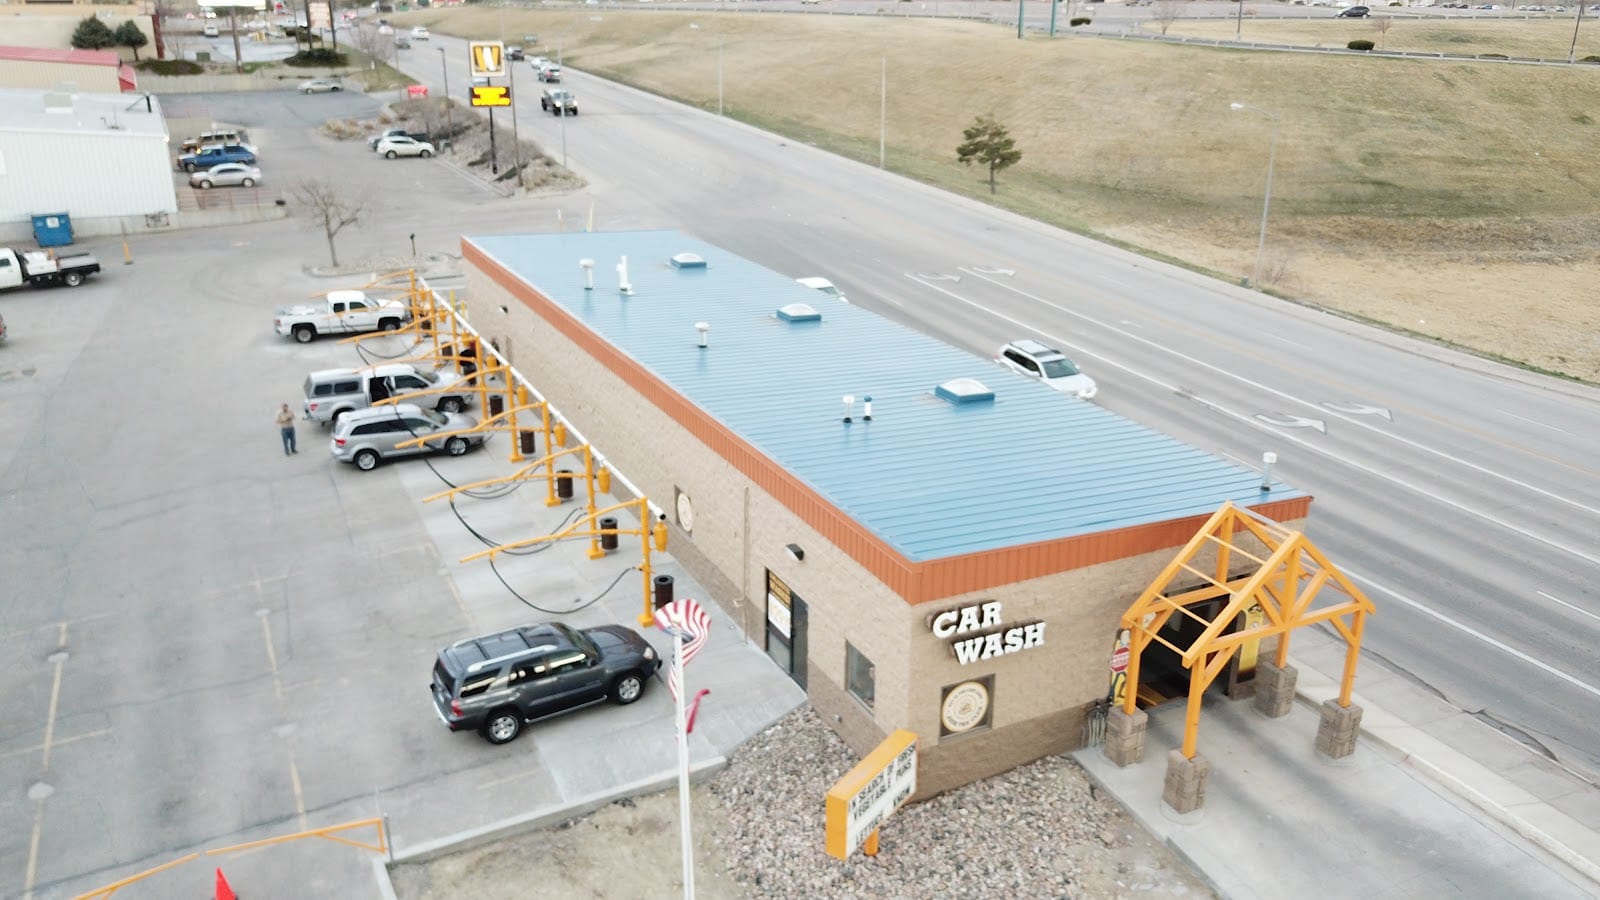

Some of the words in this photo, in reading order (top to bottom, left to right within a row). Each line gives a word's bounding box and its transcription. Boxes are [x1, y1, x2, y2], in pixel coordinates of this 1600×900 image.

[932, 601, 1002, 639] CAR
[953, 621, 1046, 665] WASH
[859, 773, 884, 800] SEARCH
